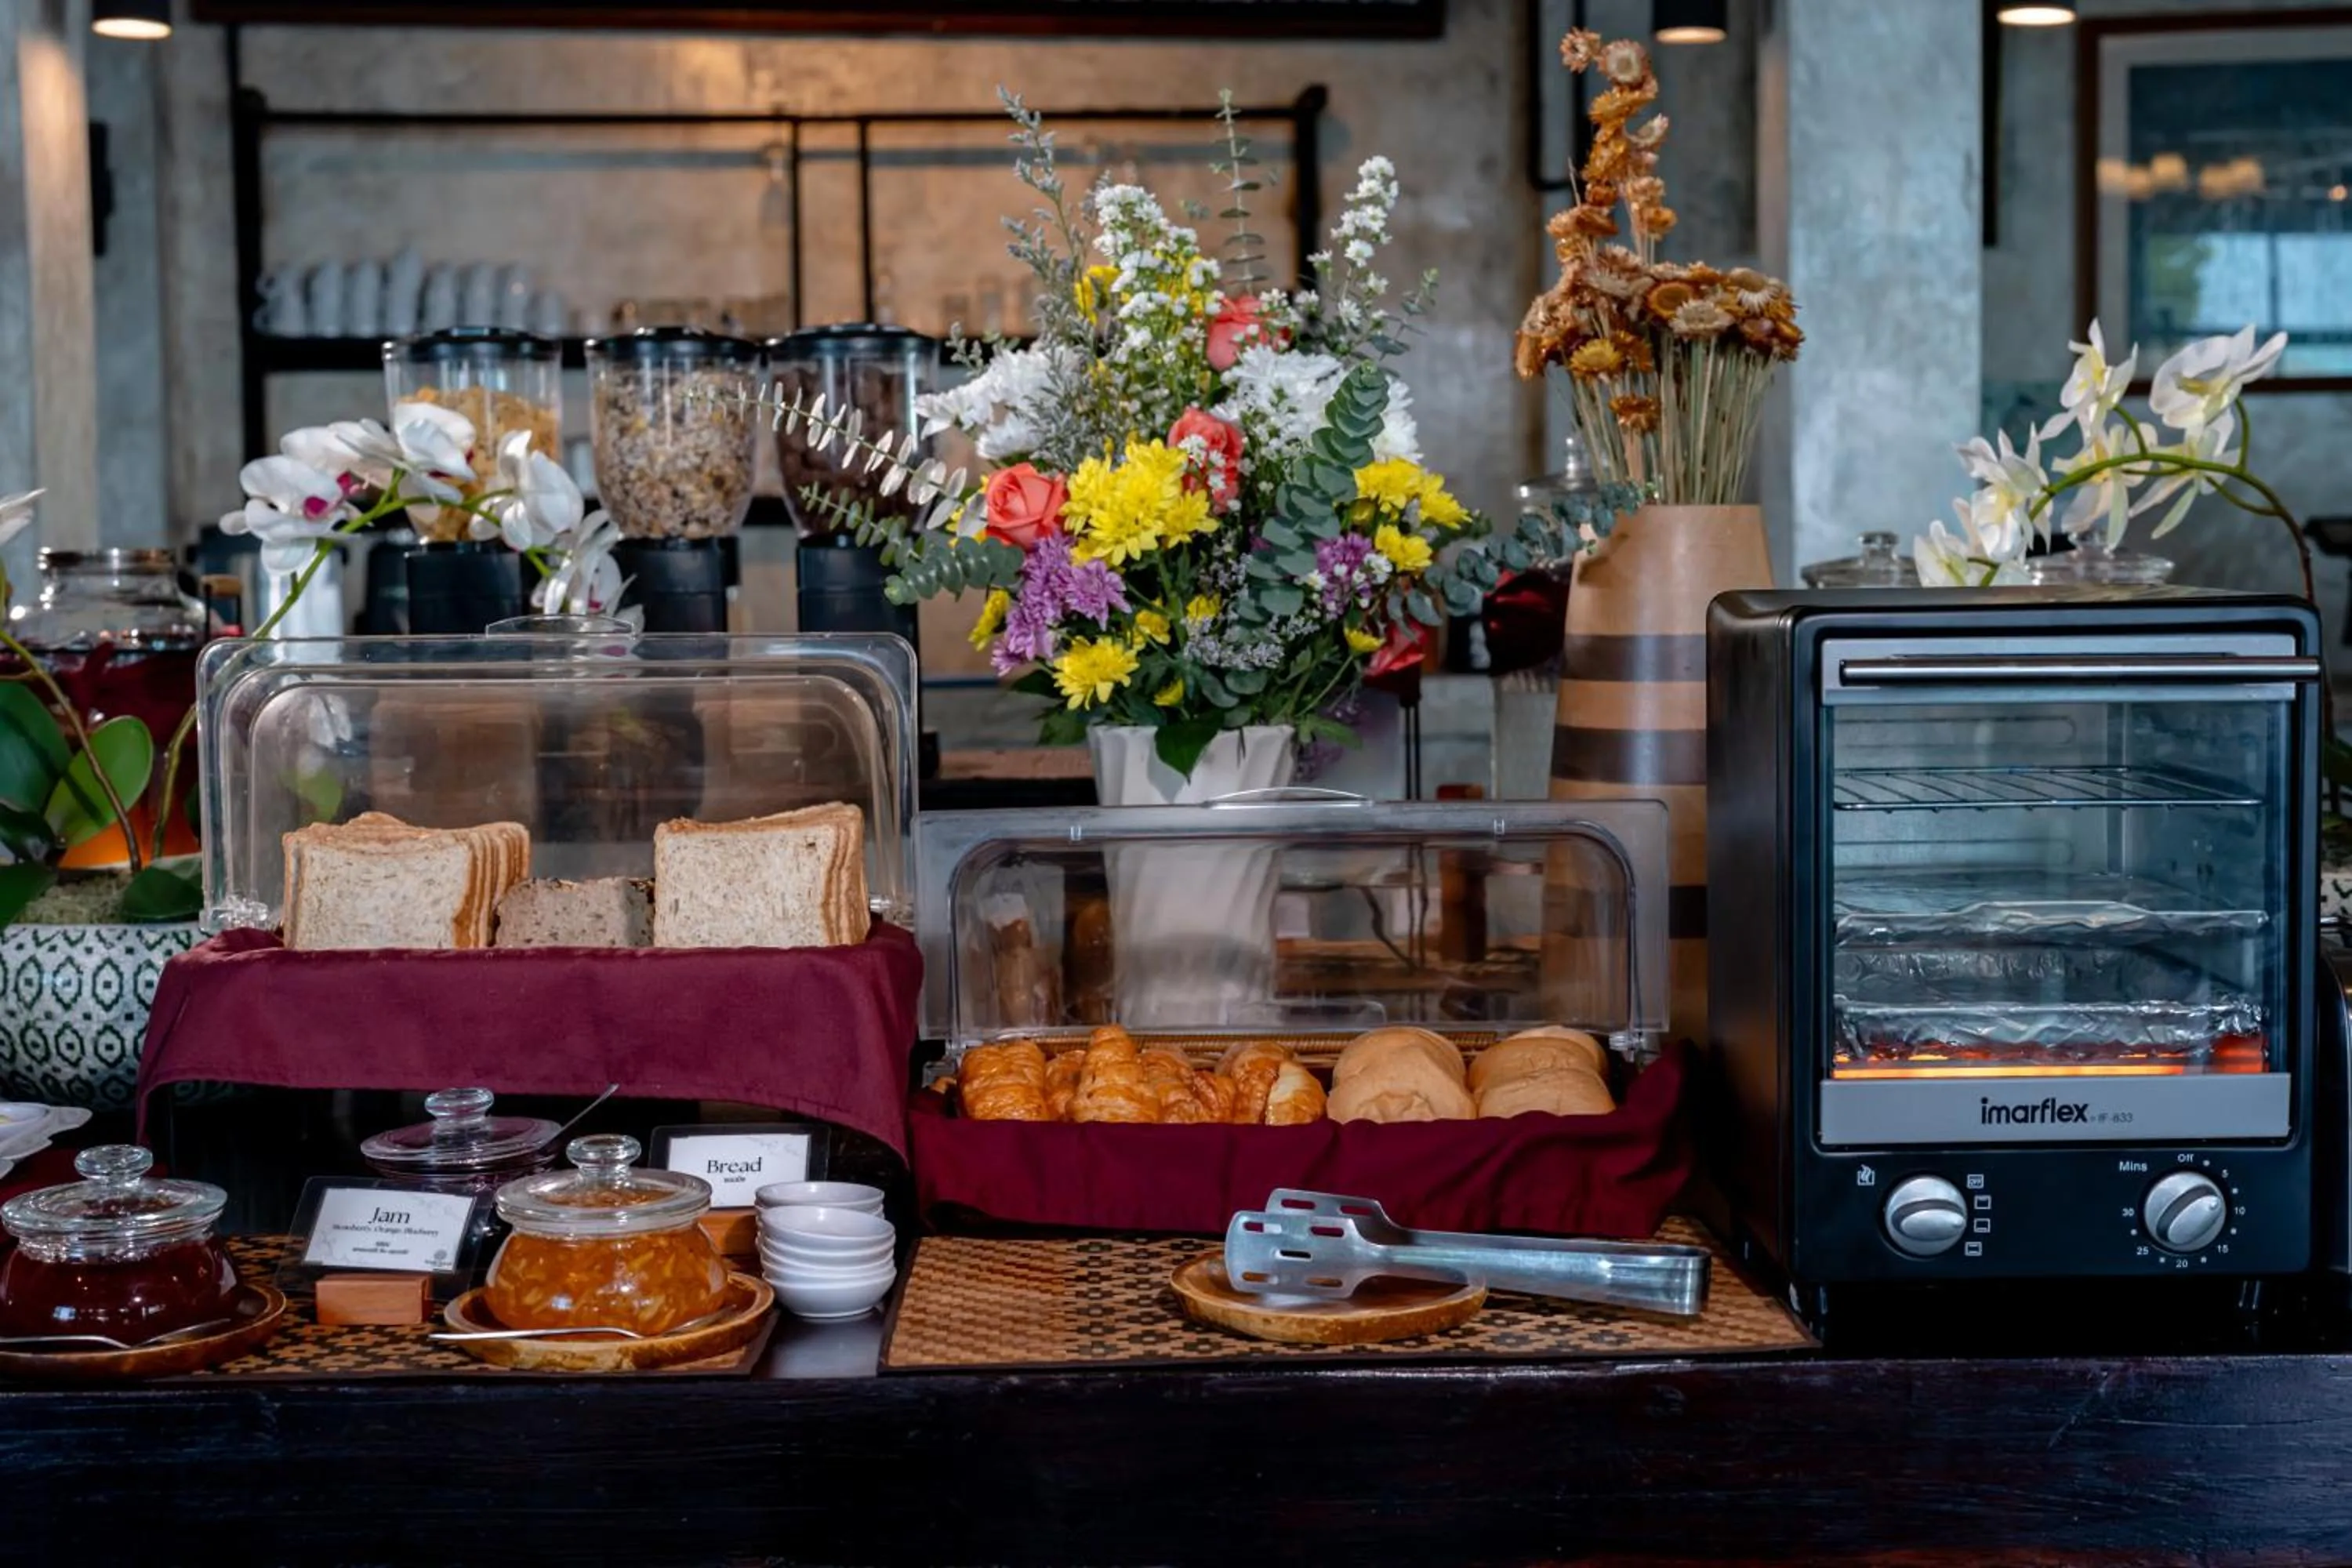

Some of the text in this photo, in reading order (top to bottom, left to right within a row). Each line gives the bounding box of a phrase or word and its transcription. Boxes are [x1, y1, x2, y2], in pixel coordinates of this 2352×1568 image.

[1980, 1097, 2089, 1124] imarflex
[2177, 1153, 2194, 1163] Off
[707, 1156, 762, 1174] Bread
[2119, 1161, 2148, 1172] Mins
[2222, 1169, 2229, 1178] 5
[368, 1207, 410, 1224] Jam
[2122, 1207, 2135, 1216] 30
[2234, 1207, 2246, 1215] 10
[2136, 1247, 2149, 1255] 25
[2217, 1244, 2229, 1253] 15
[2176, 1259, 2188, 1268] 20
